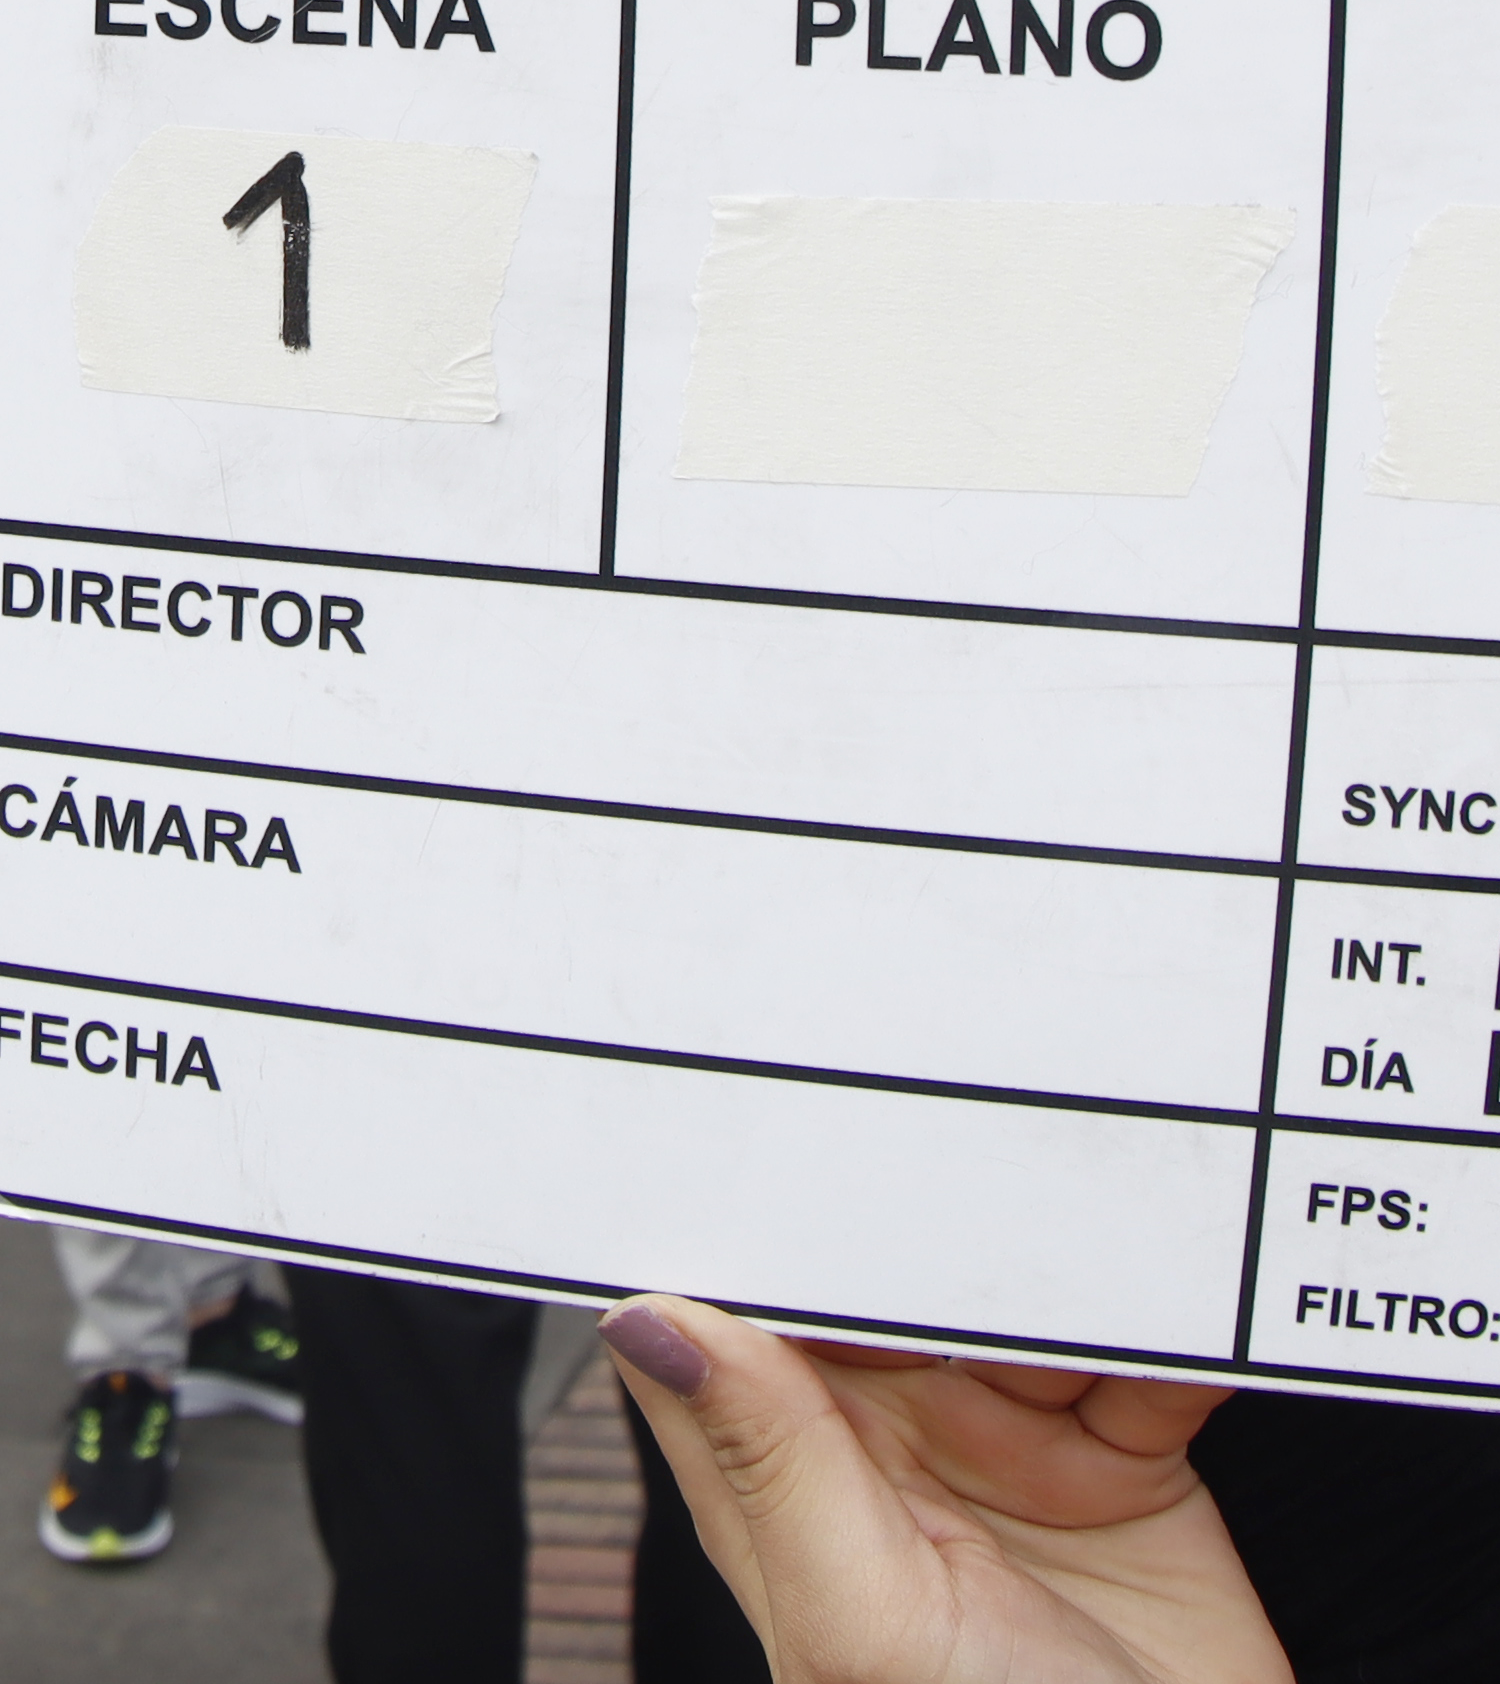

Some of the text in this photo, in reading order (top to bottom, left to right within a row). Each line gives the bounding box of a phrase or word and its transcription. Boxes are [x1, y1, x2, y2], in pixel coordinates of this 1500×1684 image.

[221, 150, 312, 352] 1
[0, 561, 367, 655] DIRECTOR
[1341, 782, 1498, 836] SYNC
[1330, 937, 1426, 987] INT.
[1320, 1037, 1415, 1094] DÍA
[1306, 1181, 1429, 1233] FPS:
